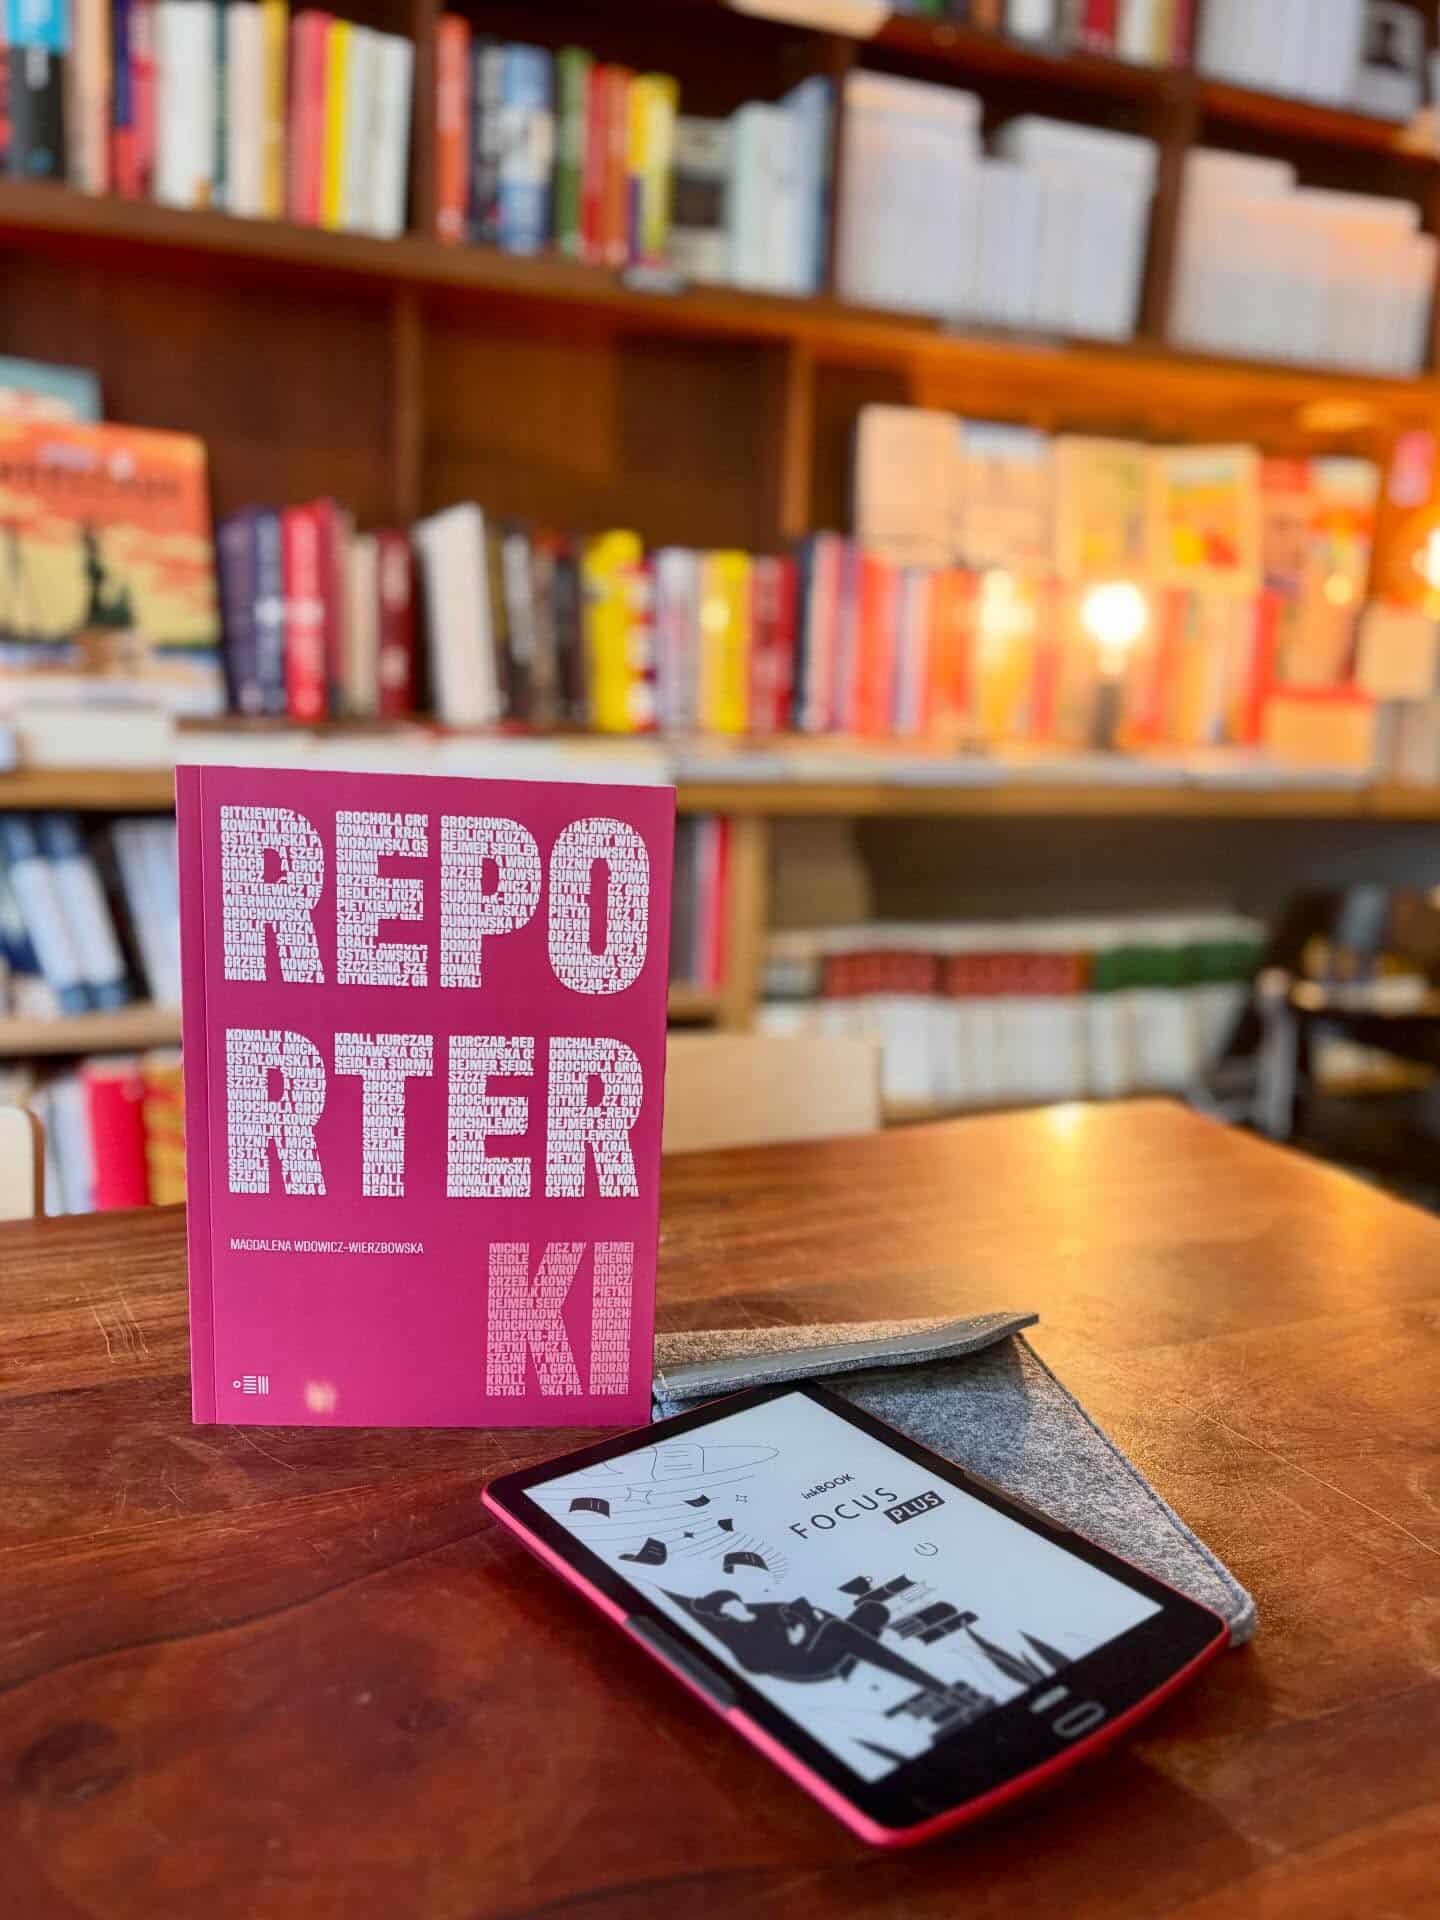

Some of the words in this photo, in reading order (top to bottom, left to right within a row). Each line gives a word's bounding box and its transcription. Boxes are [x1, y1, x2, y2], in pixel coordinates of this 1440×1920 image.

[336, 823, 392, 838] KOWALIK
[220, 805, 650, 995] REPO
[226, 1028, 643, 1198] RTER
[230, 1238, 291, 1251] MAGDALENA
[293, 1240, 425, 1254] WDOWICZ-WIERZBOWSKA
[486, 1242, 634, 1396] KI
[801, 1473, 855, 1500] inkBOOK
[789, 1488, 898, 1539] FOCUS
[889, 1493, 940, 1522] PLUS
